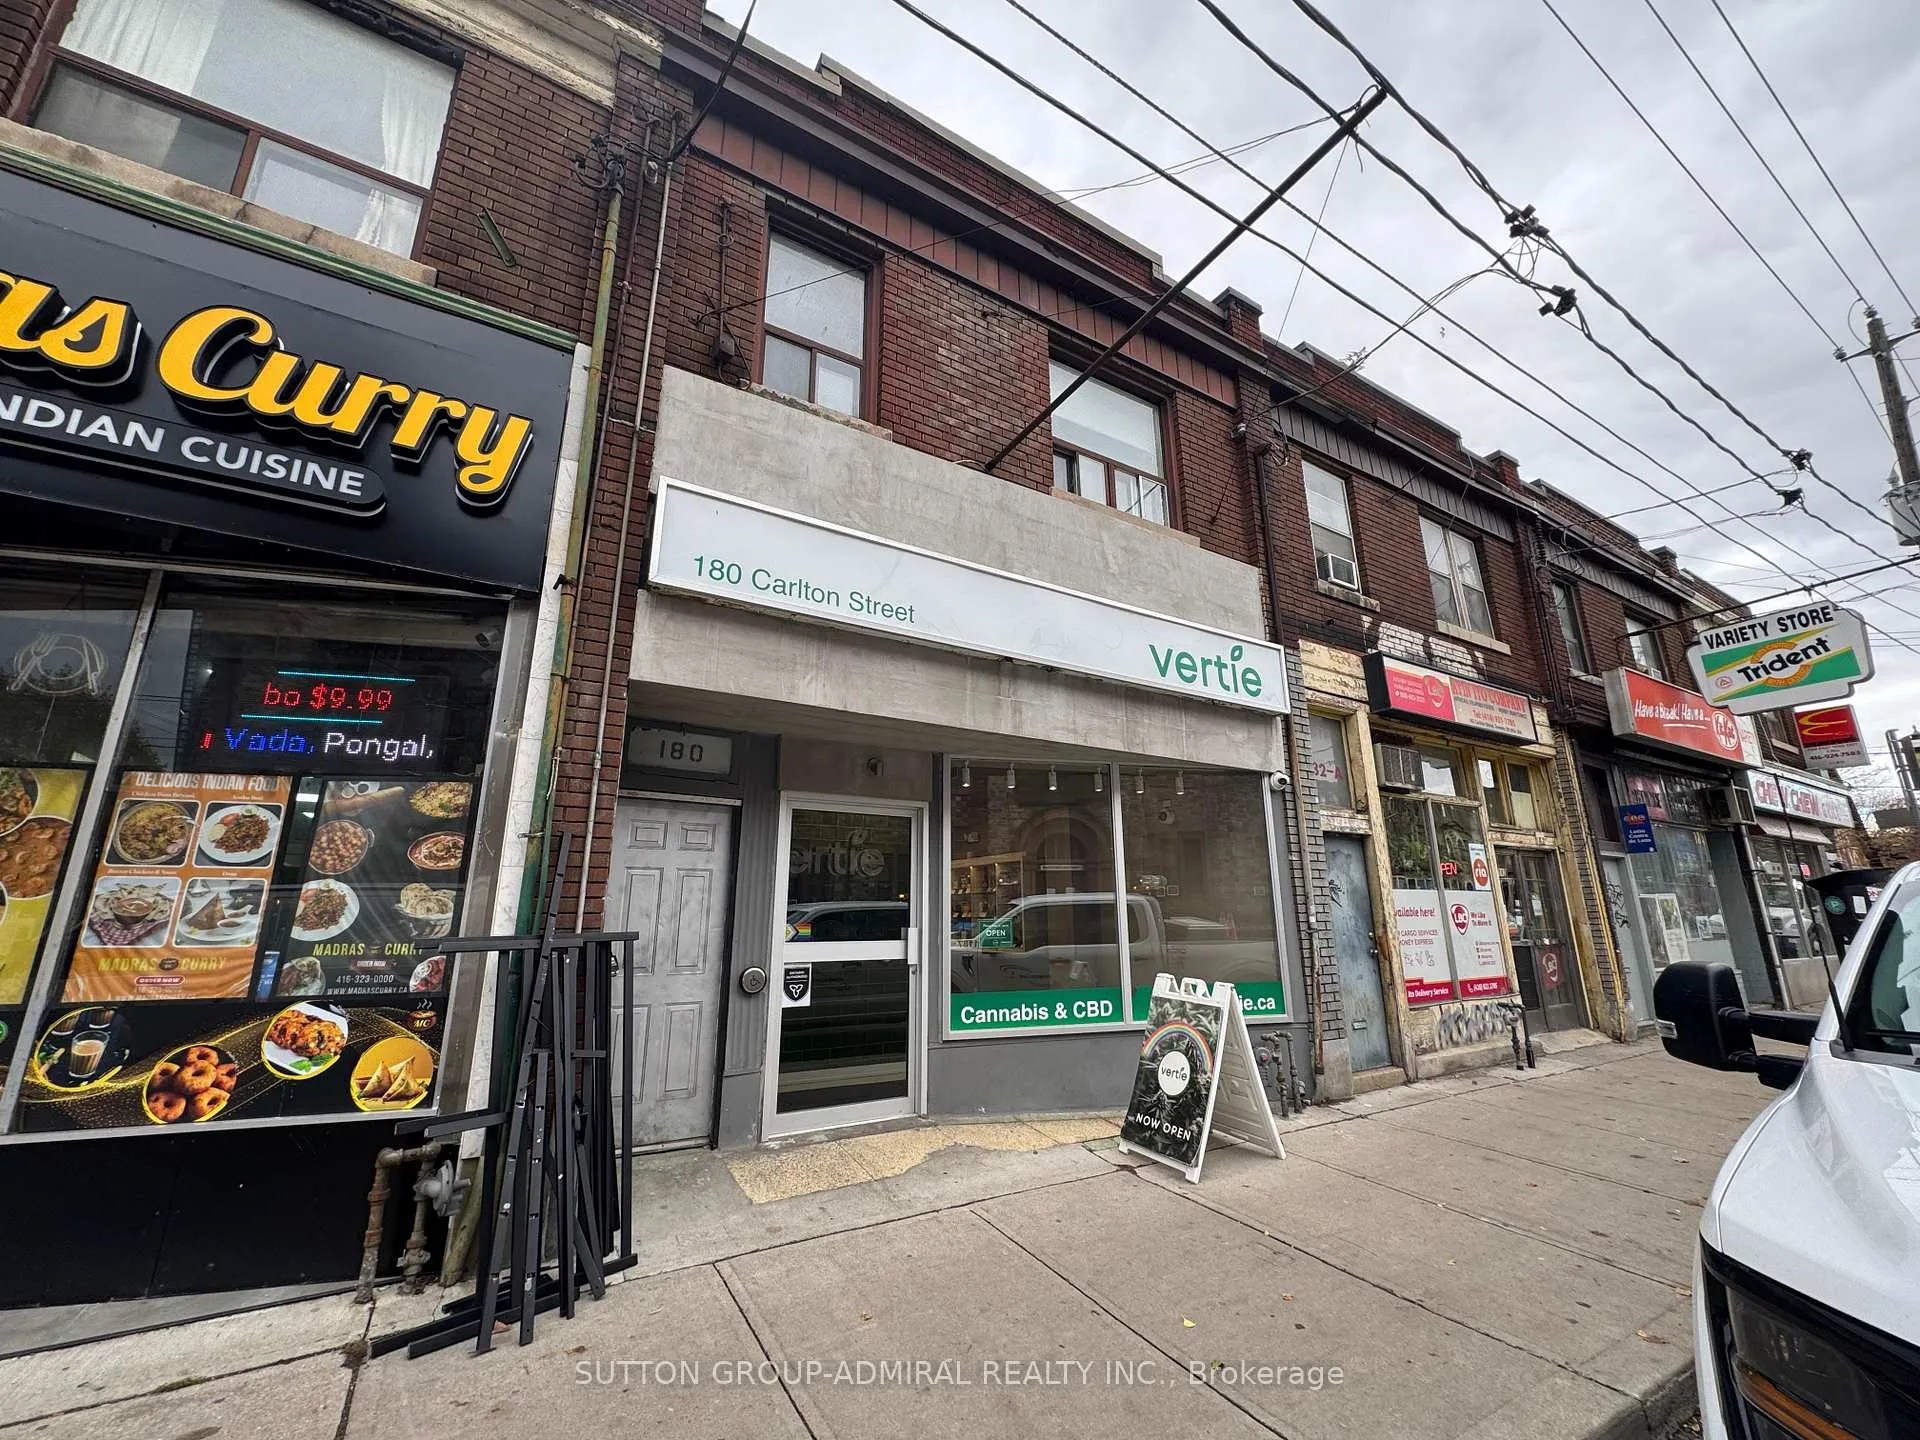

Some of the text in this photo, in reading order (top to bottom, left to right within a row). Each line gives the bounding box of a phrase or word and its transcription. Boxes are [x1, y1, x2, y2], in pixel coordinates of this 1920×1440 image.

[157, 305, 533, 494] Curry
[180, 435, 364, 497] CUISINE
[693, 554, 915, 624] 180 Carlton Street
[1704, 605, 1834, 650] VARIETY STORE
[1148, 643, 1263, 698] vertie
[1736, 636, 1831, 683] Trident
[310, 683, 393, 711] $9.99
[1635, 699, 1654, 718] Have
[224, 728, 315, 755] Vada,
[324, 732, 433, 761] Pongal,
[658, 740, 704, 763] 180
[136, 771, 280, 792] DELICIOUS INDIAN FOOD
[1440, 862, 1457, 876] PEN
[1394, 906, 1435, 918] vailable here!
[985, 929, 1006, 937] OPEN
[1399, 938, 1413, 946] ONEY
[312, 943, 366, 957] MADRAS
[98, 957, 156, 972] MADRAS
[178, 956, 226, 972] CURRY
[335, 974, 394, 984] 416-323-0000
[960, 999, 1114, 1025] Cannabis & CBD
[1160, 1066, 1188, 1081] vertie
[1135, 1112, 1192, 1141] NOW OPEN
